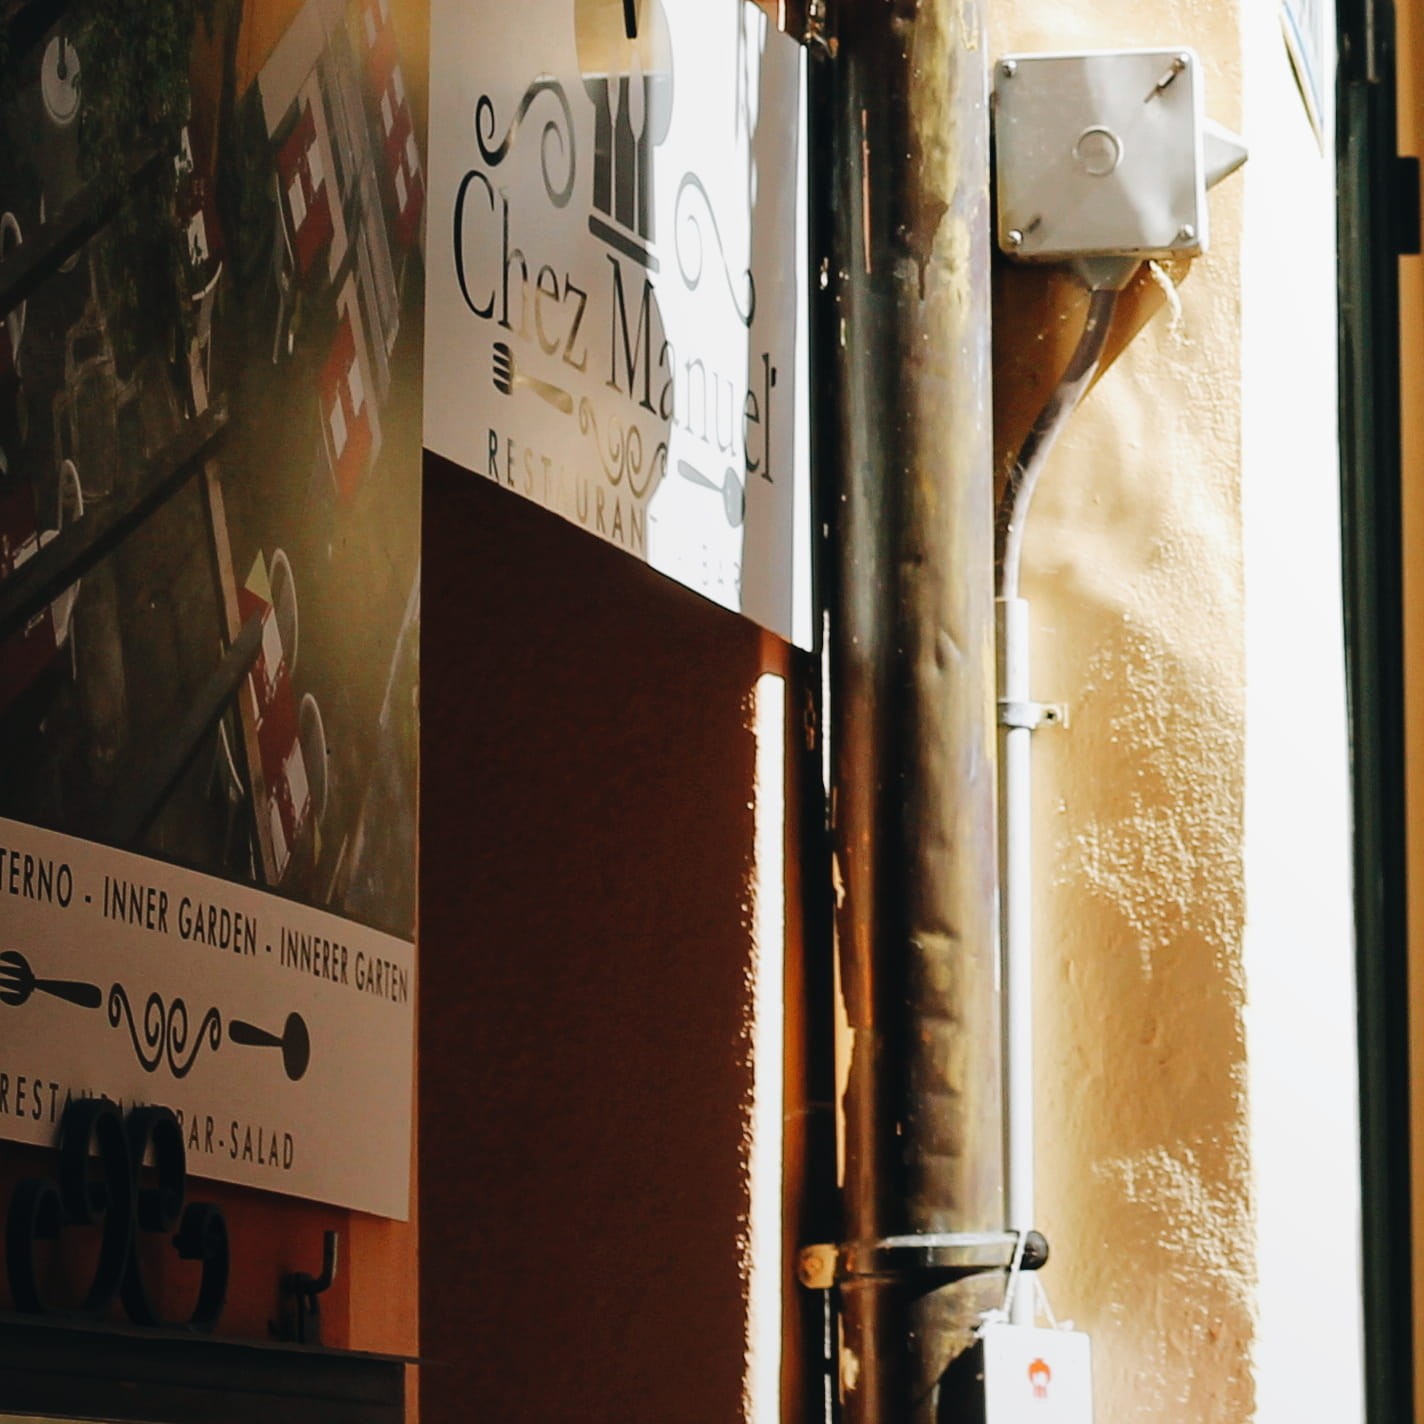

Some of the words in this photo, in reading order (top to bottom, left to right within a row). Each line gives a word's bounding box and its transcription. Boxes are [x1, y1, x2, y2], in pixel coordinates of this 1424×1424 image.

[452, 168, 588, 373] Chez
[606, 252, 774, 485] Manuel
[488, 428, 659, 551] RESTURAN
[0, 847, 73, 909] TERNO
[104, 875, 169, 934] INNER
[178, 896, 257, 957] GARDEN
[280, 926, 349, 985] INNERER
[355, 951, 408, 1003] GARTEN
